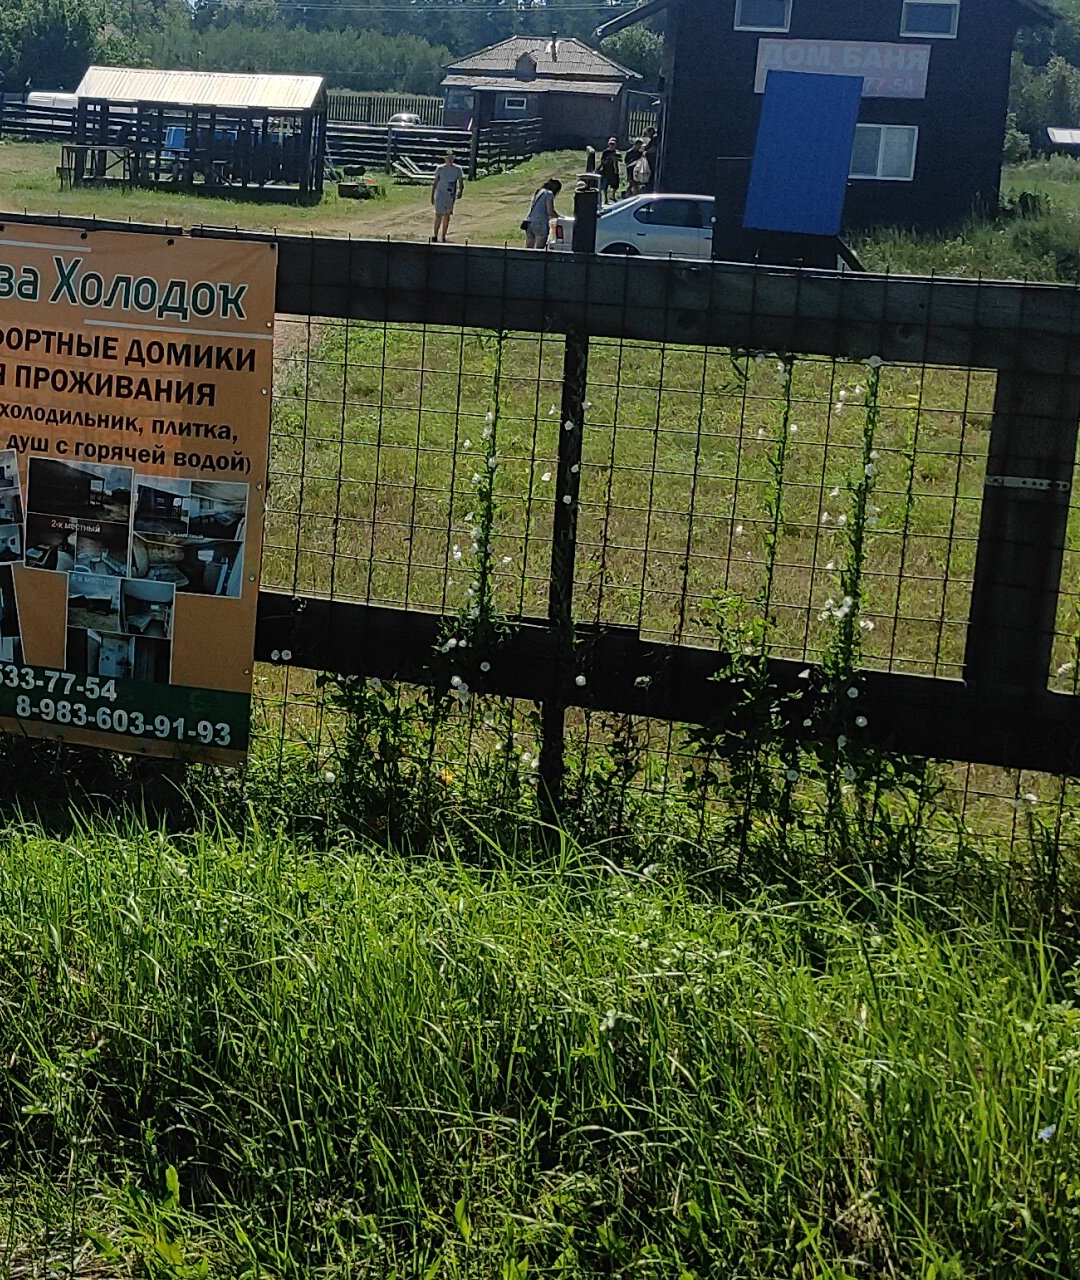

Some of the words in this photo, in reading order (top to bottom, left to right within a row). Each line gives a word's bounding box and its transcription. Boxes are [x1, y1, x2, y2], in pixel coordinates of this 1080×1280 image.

[842, 47, 928, 71] БАНЯ
[49, 256, 249, 322] Холодок
[124, 339, 257, 372] ДОМИКИ
[15, 365, 216, 407] ПРОЖИВАНИЯ
[0, 402, 144, 435] холодильник,
[152, 419, 238, 444] плитка,
[6, 432, 49, 455] душ
[55, 439, 68, 455] с
[74, 440, 166, 466] горячей
[173, 451, 252, 475] водой)
[16, 695, 231, 746] 8-983-603-91-93
